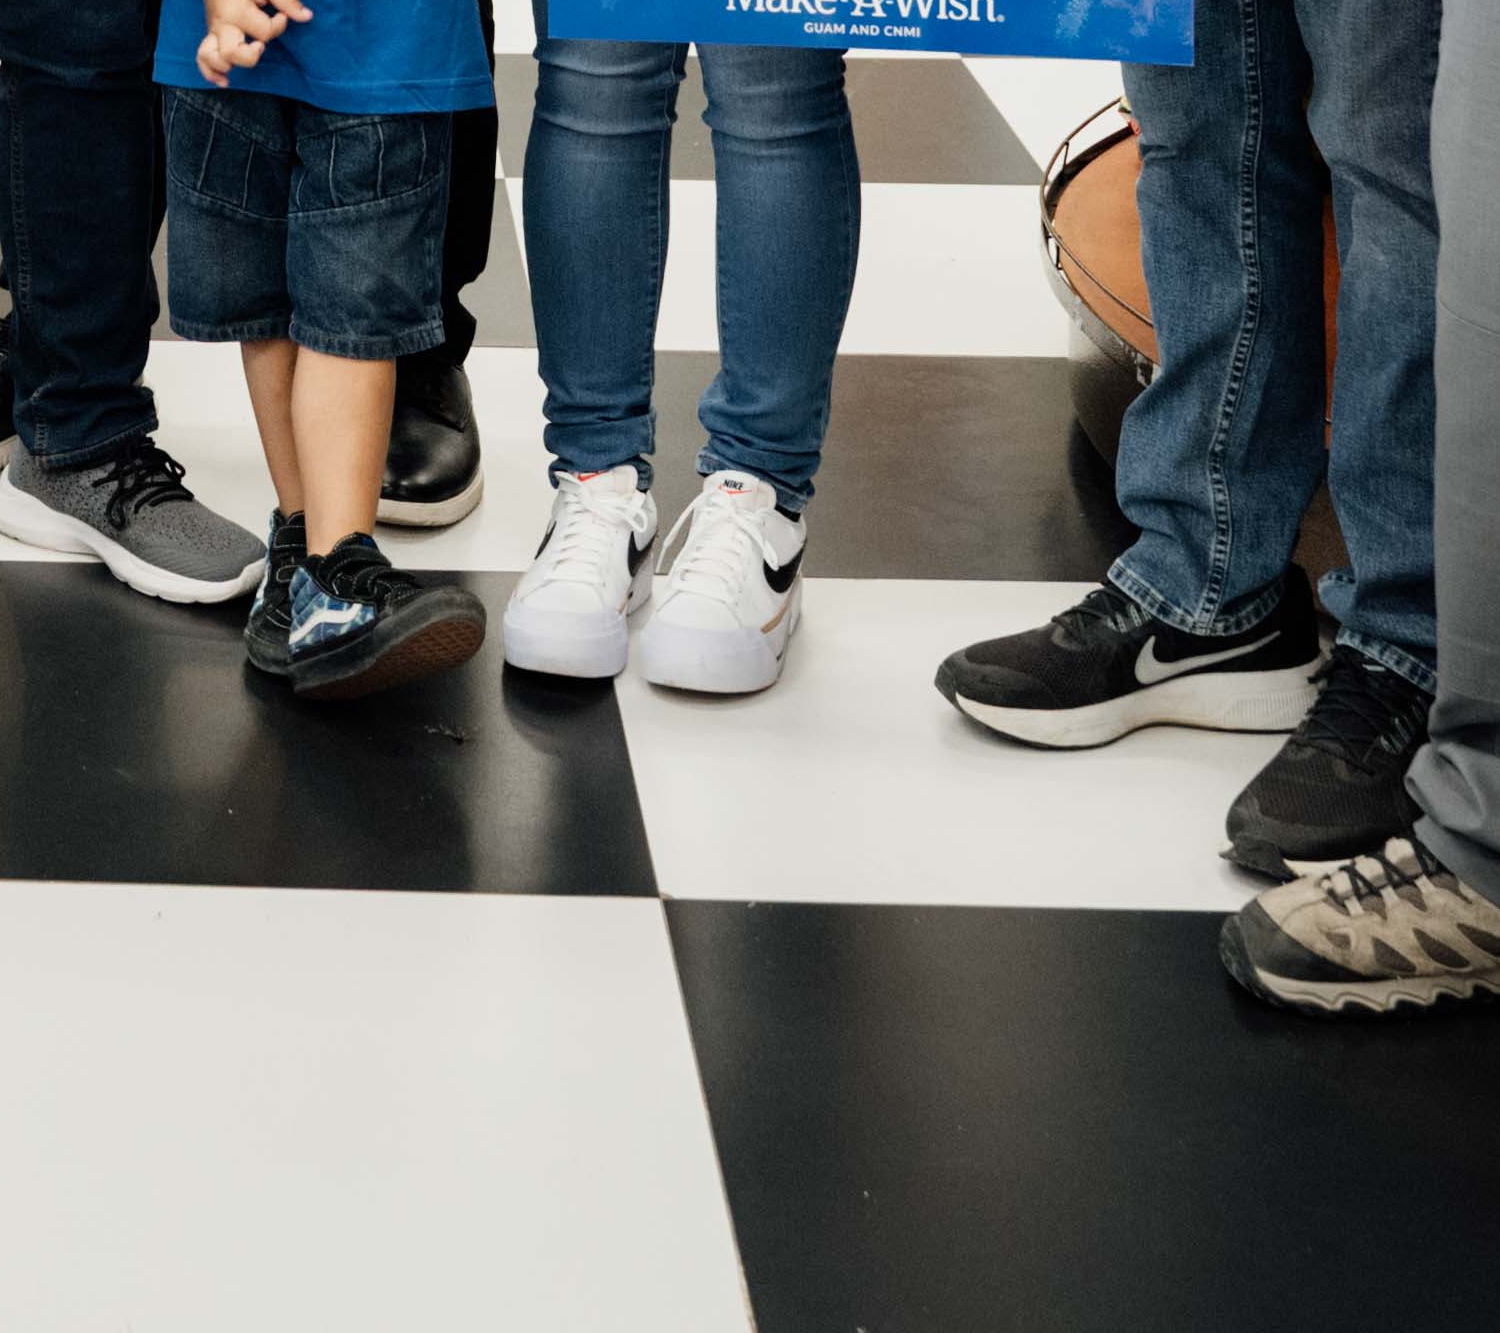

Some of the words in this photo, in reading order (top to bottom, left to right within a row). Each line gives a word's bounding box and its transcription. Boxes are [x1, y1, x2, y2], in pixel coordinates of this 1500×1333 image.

[803, 22, 848, 37] GUAM
[850, 23, 881, 37] AND
[883, 24, 922, 39] CNMI
